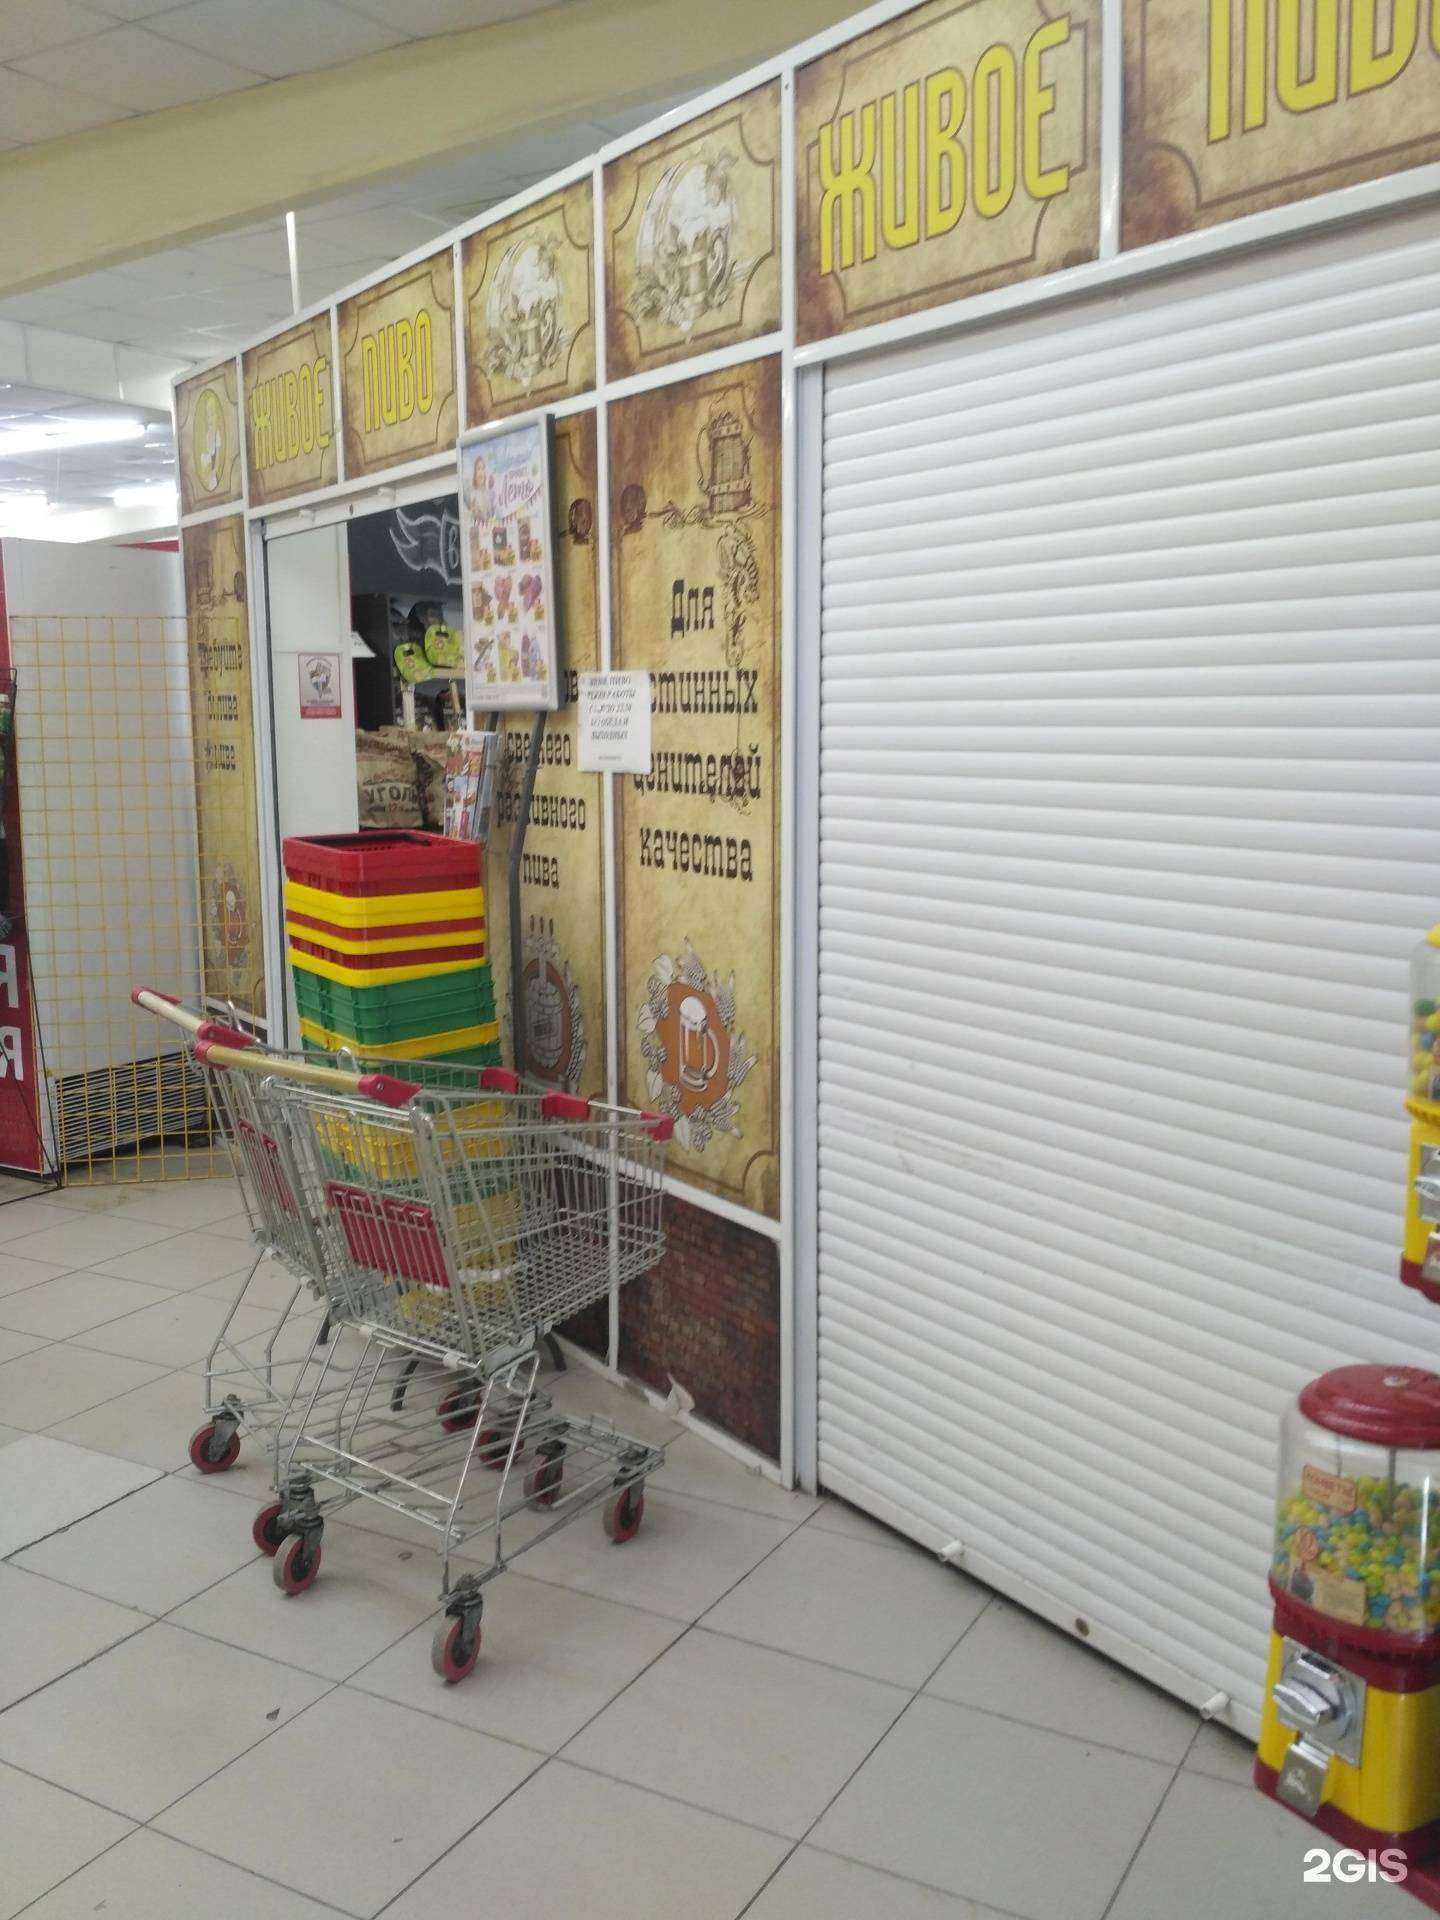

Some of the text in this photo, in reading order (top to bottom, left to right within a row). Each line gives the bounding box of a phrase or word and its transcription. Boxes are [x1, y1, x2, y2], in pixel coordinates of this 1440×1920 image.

[819, 0, 1440, 277] ЖИВОЕ ПИВ
[252, 309, 433, 470] ЖИВОЕ ПИВО
[670, 578, 715, 640] Для
[649, 670, 758, 714] стинных
[505, 731, 571, 766] свеего
[497, 790, 586, 831] разивного
[523, 853, 560, 889] пива
[639, 826, 753, 883] качества
